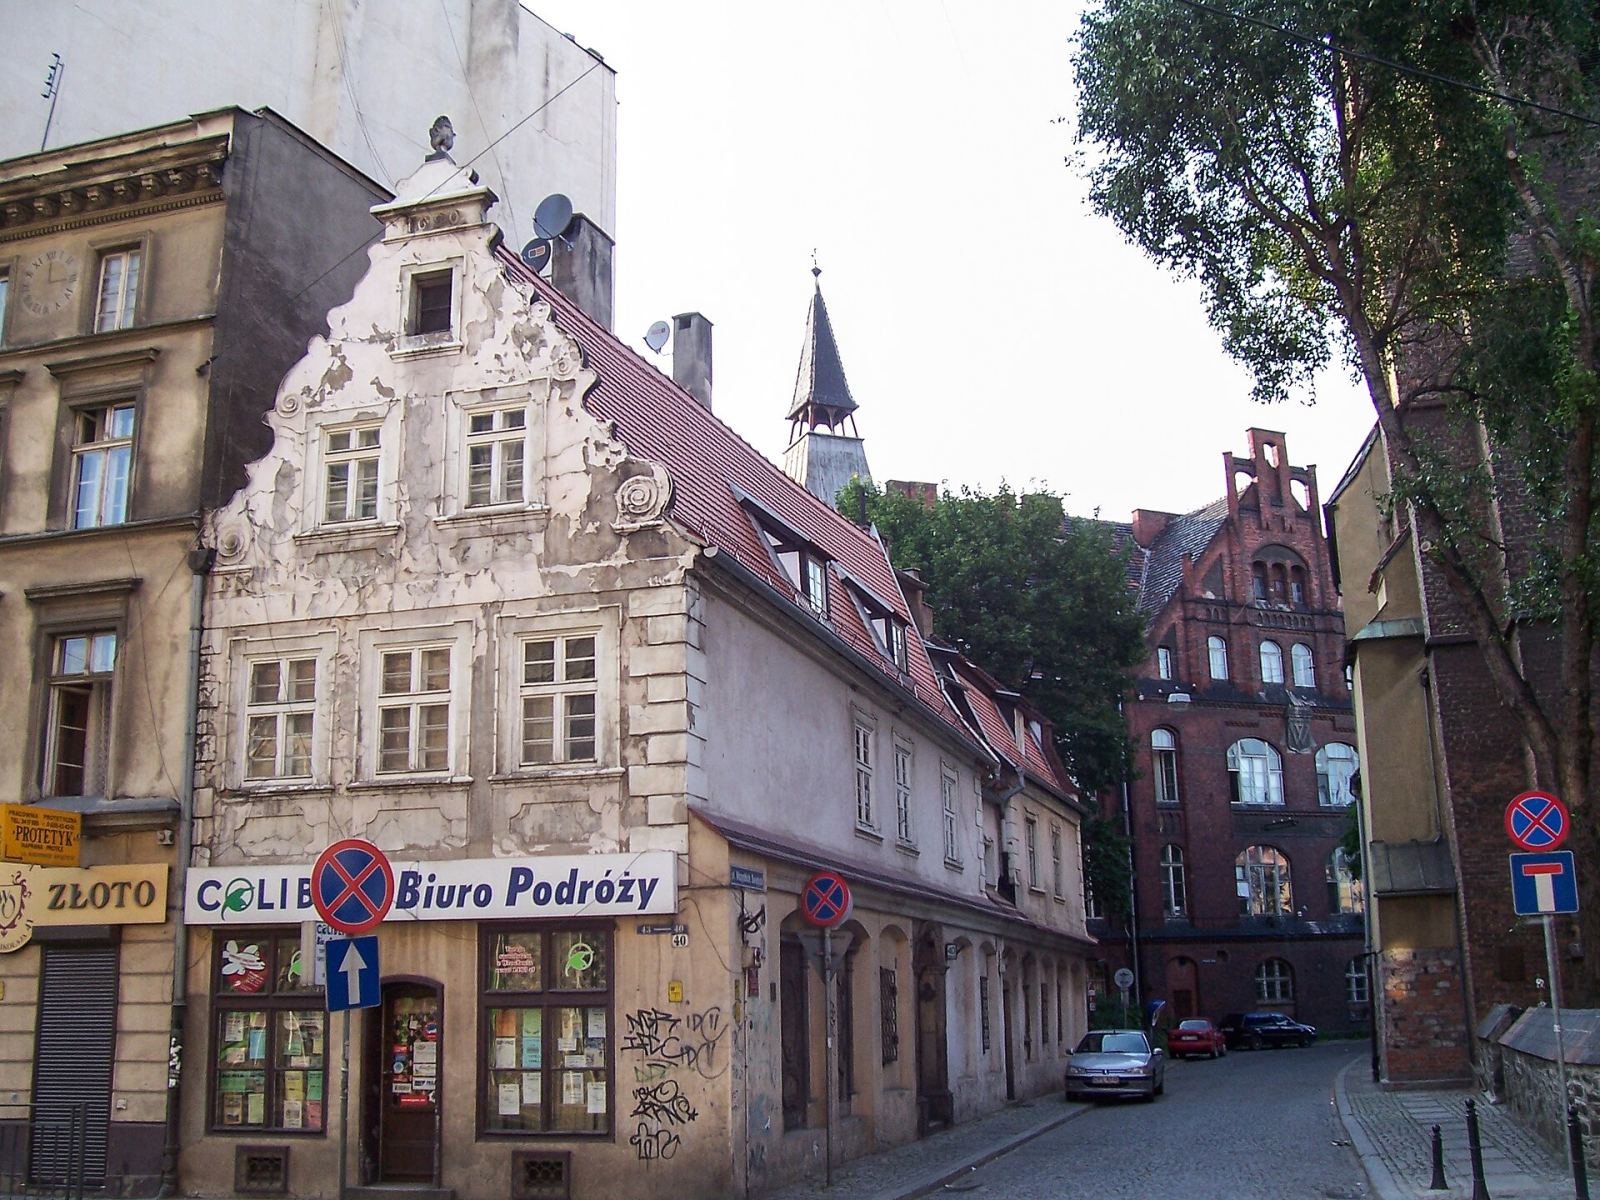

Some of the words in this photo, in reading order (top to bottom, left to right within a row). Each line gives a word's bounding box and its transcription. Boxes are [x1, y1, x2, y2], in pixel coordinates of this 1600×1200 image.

[15, 825, 73, 846] PROTETYK
[47, 880, 155, 910] ZŁOTO
[395, 870, 492, 910] Biuro
[505, 867, 659, 911] Podróży
[673, 935, 686, 946] 40
